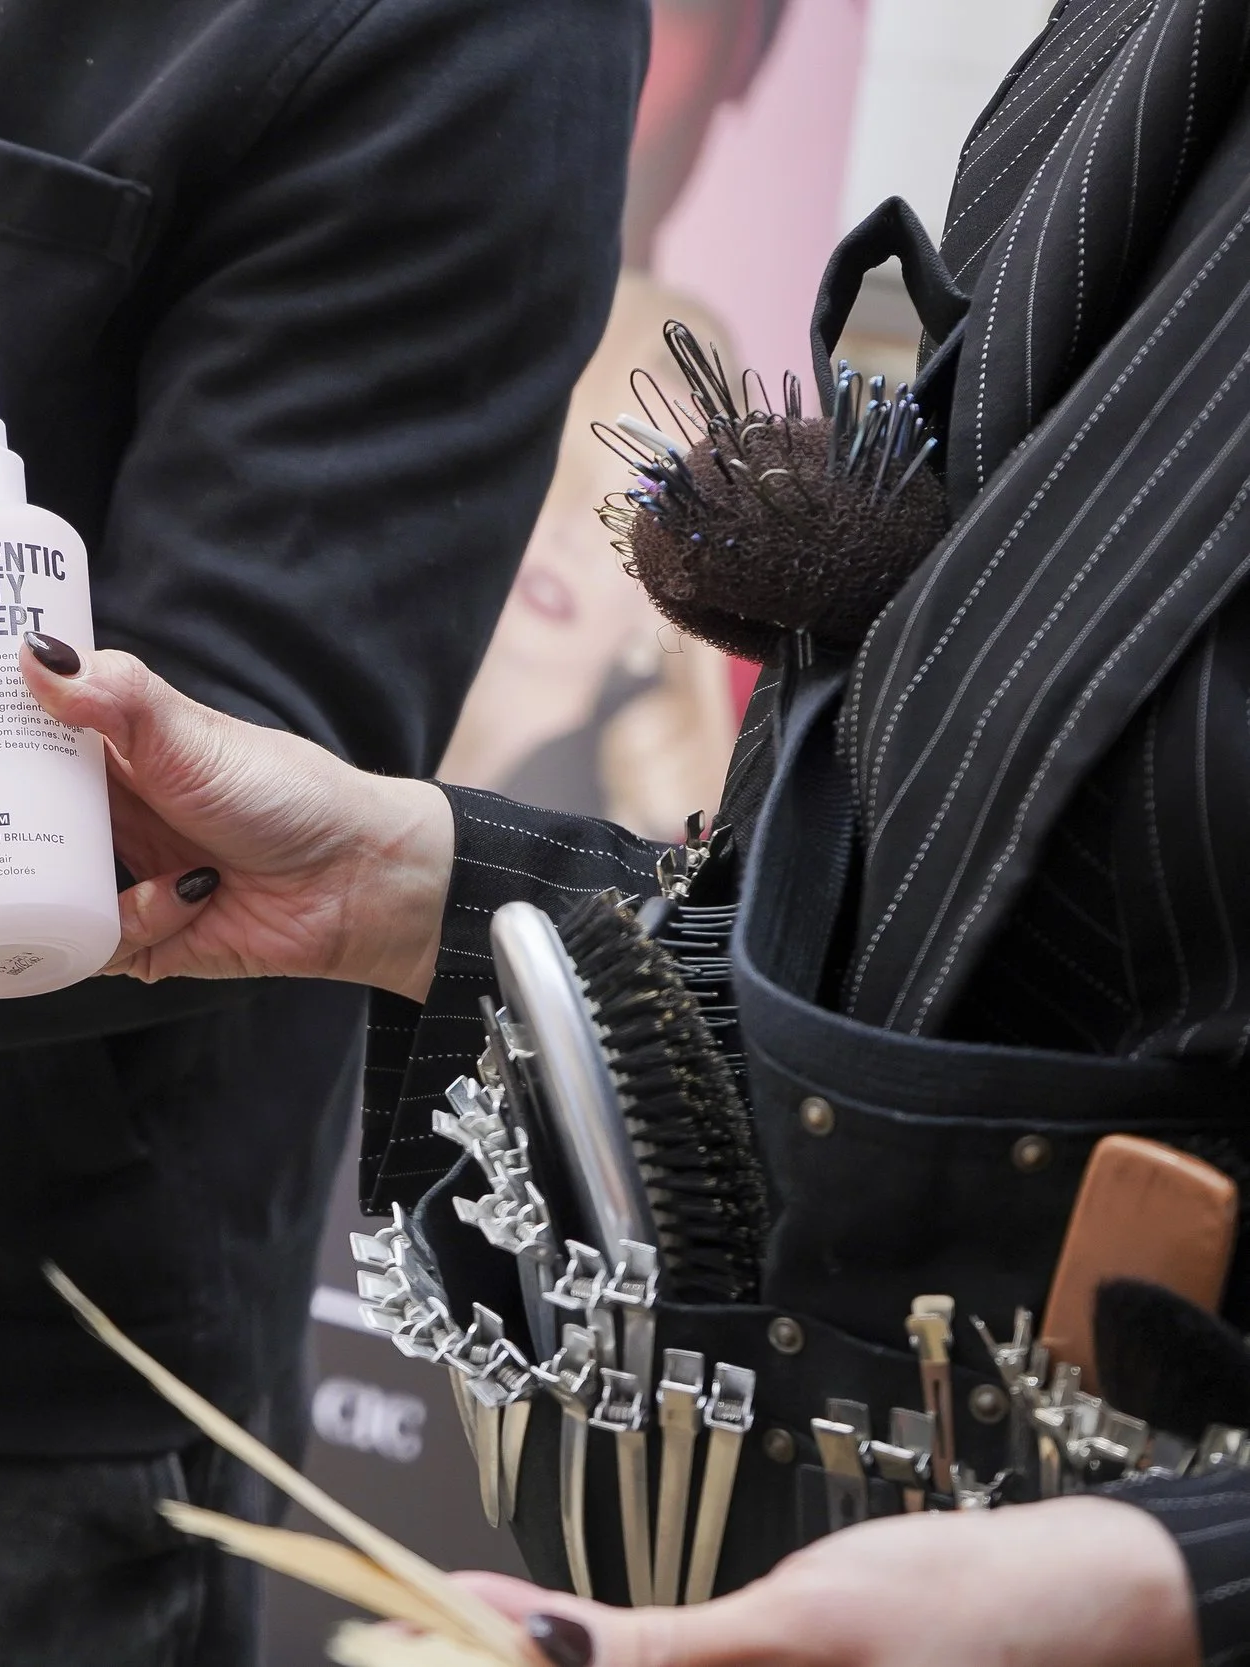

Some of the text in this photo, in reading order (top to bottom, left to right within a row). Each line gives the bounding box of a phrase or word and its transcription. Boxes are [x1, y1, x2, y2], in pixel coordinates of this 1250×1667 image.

[6, 677, 24, 685] beli
[0, 690, 18, 698] and
[7, 716, 41, 725] origins
[43, 718, 60, 728] and
[16, 729, 59, 739] silicones.
[61, 732, 75, 743] We
[4, 740, 40, 750] beauty
[43, 743, 79, 757] concept.
[5, 833, 65, 844] BRILLANCE
